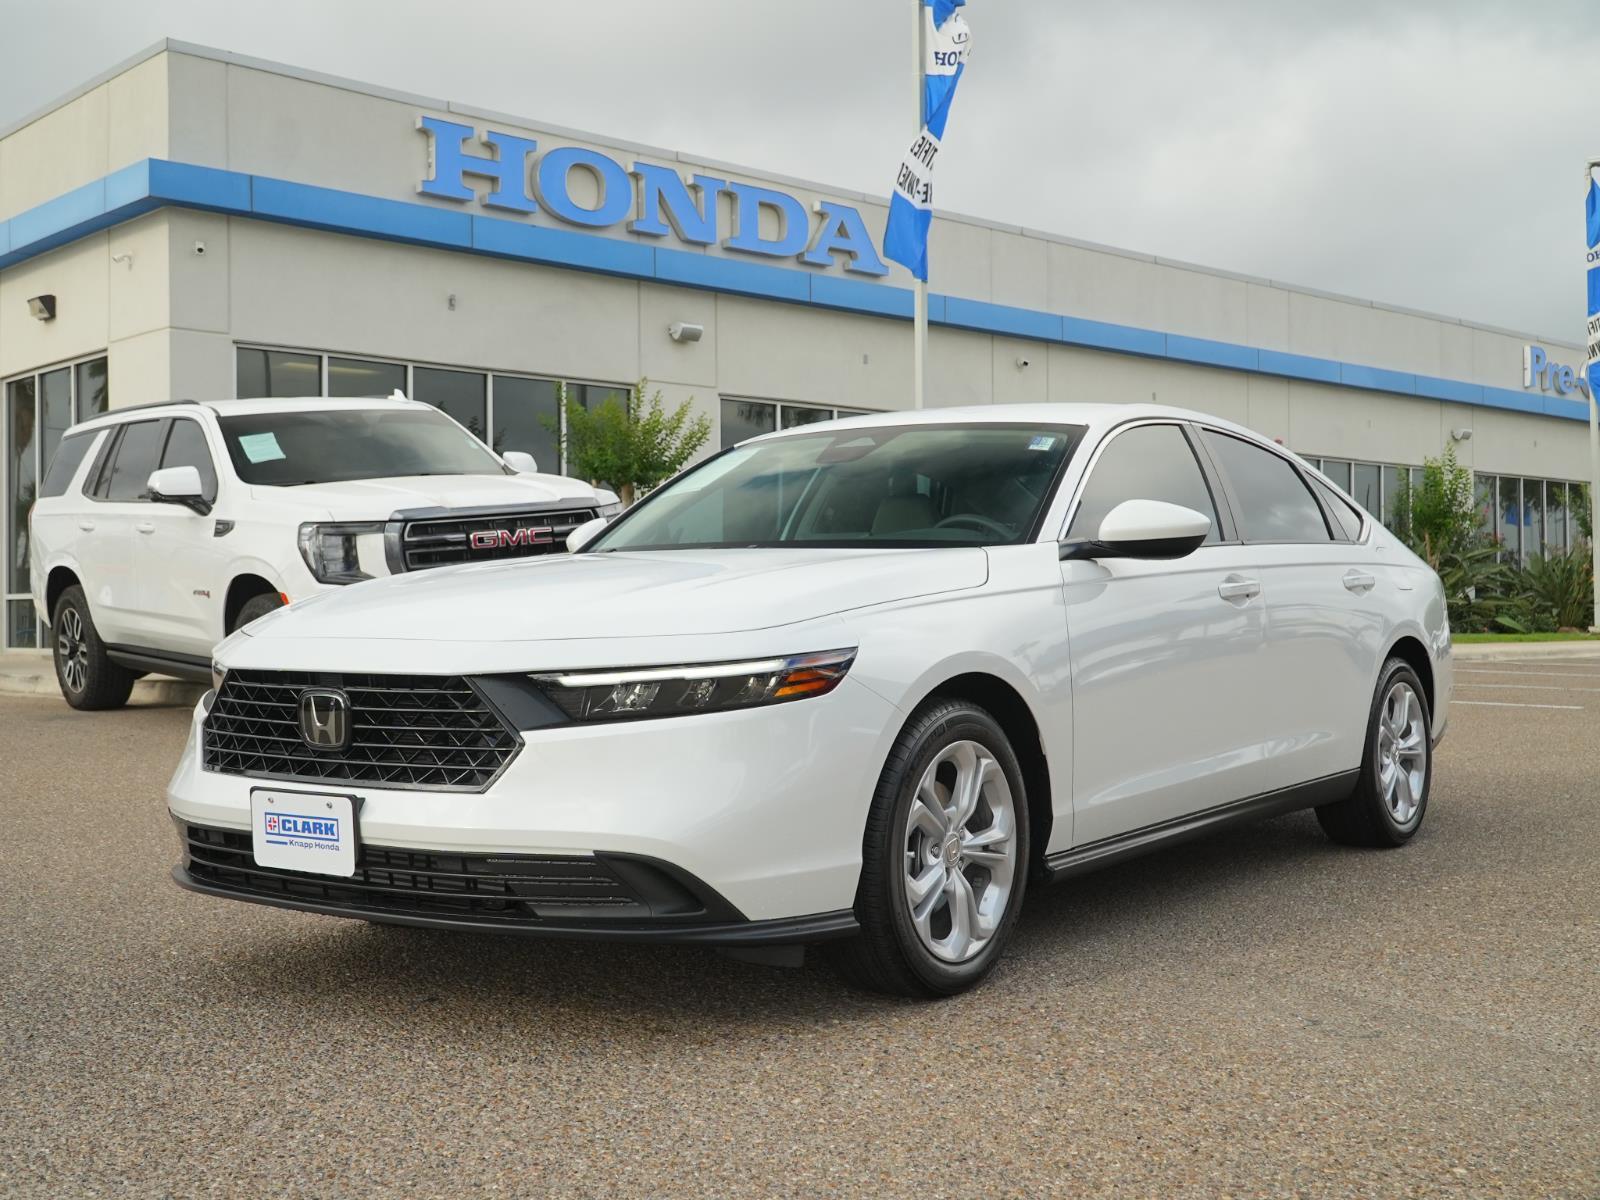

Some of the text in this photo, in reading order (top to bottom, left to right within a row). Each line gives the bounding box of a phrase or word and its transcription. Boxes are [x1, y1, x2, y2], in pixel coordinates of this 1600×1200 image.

[415, 116, 889, 276] HONDA
[470, 527, 553, 549] GMC
[281, 818, 336, 837] CLARK
[288, 839, 340, 852] Knapp Honda
